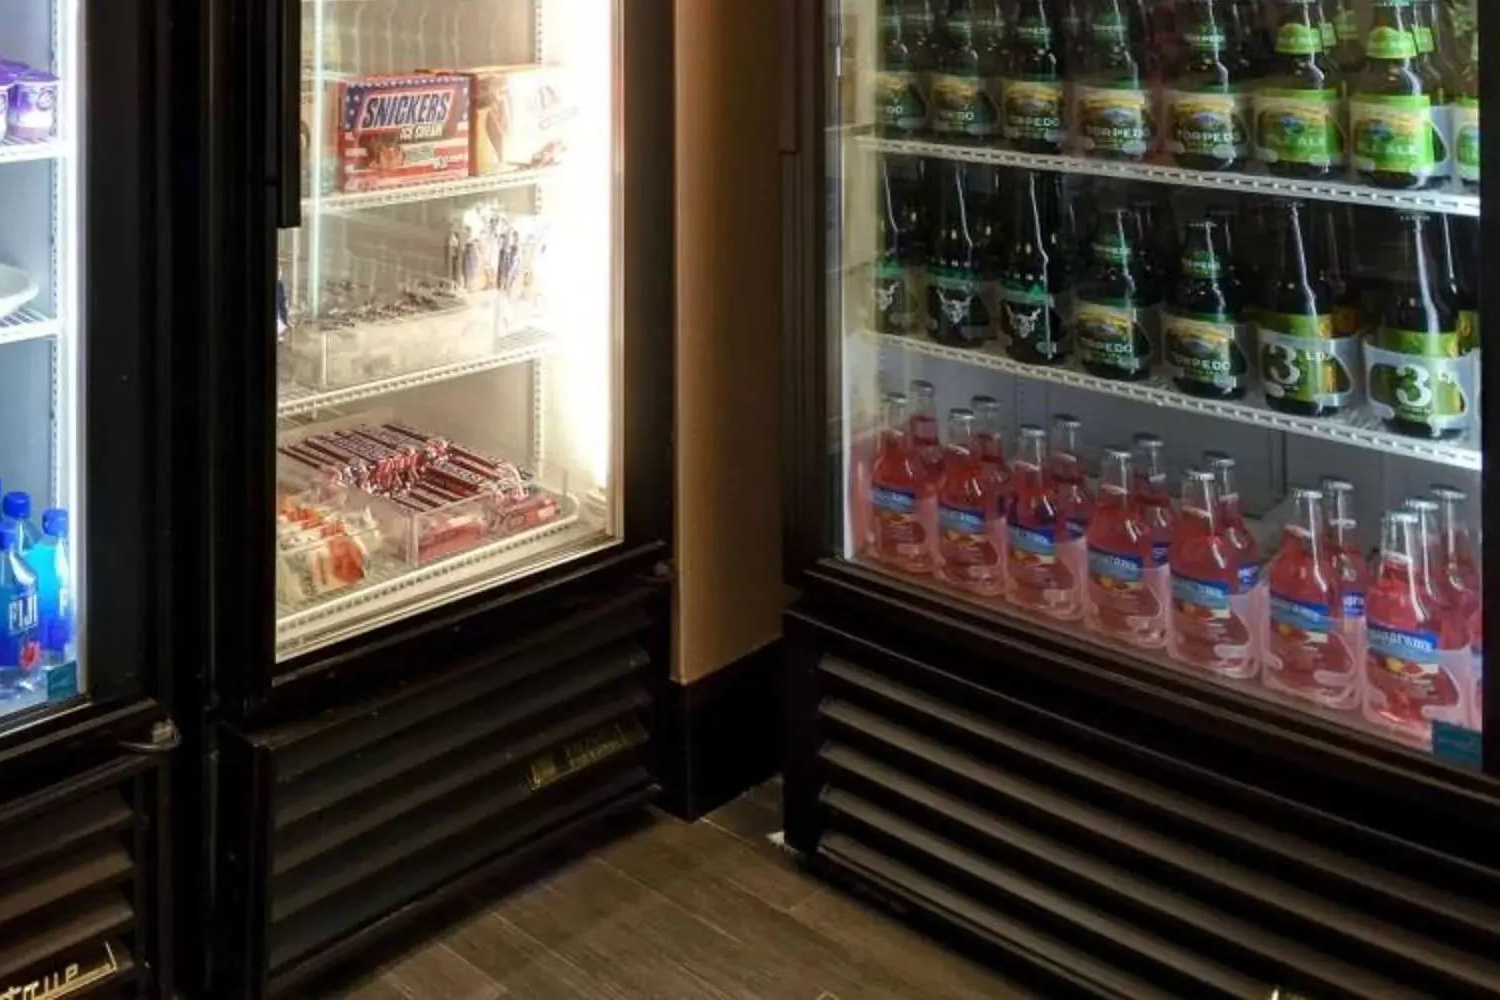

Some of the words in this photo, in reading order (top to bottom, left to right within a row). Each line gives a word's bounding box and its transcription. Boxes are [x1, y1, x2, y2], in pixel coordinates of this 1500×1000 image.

[362, 91, 453, 128] SNICKERS
[1396, 363, 1433, 407] 3
[8, 593, 38, 632] FIJI
